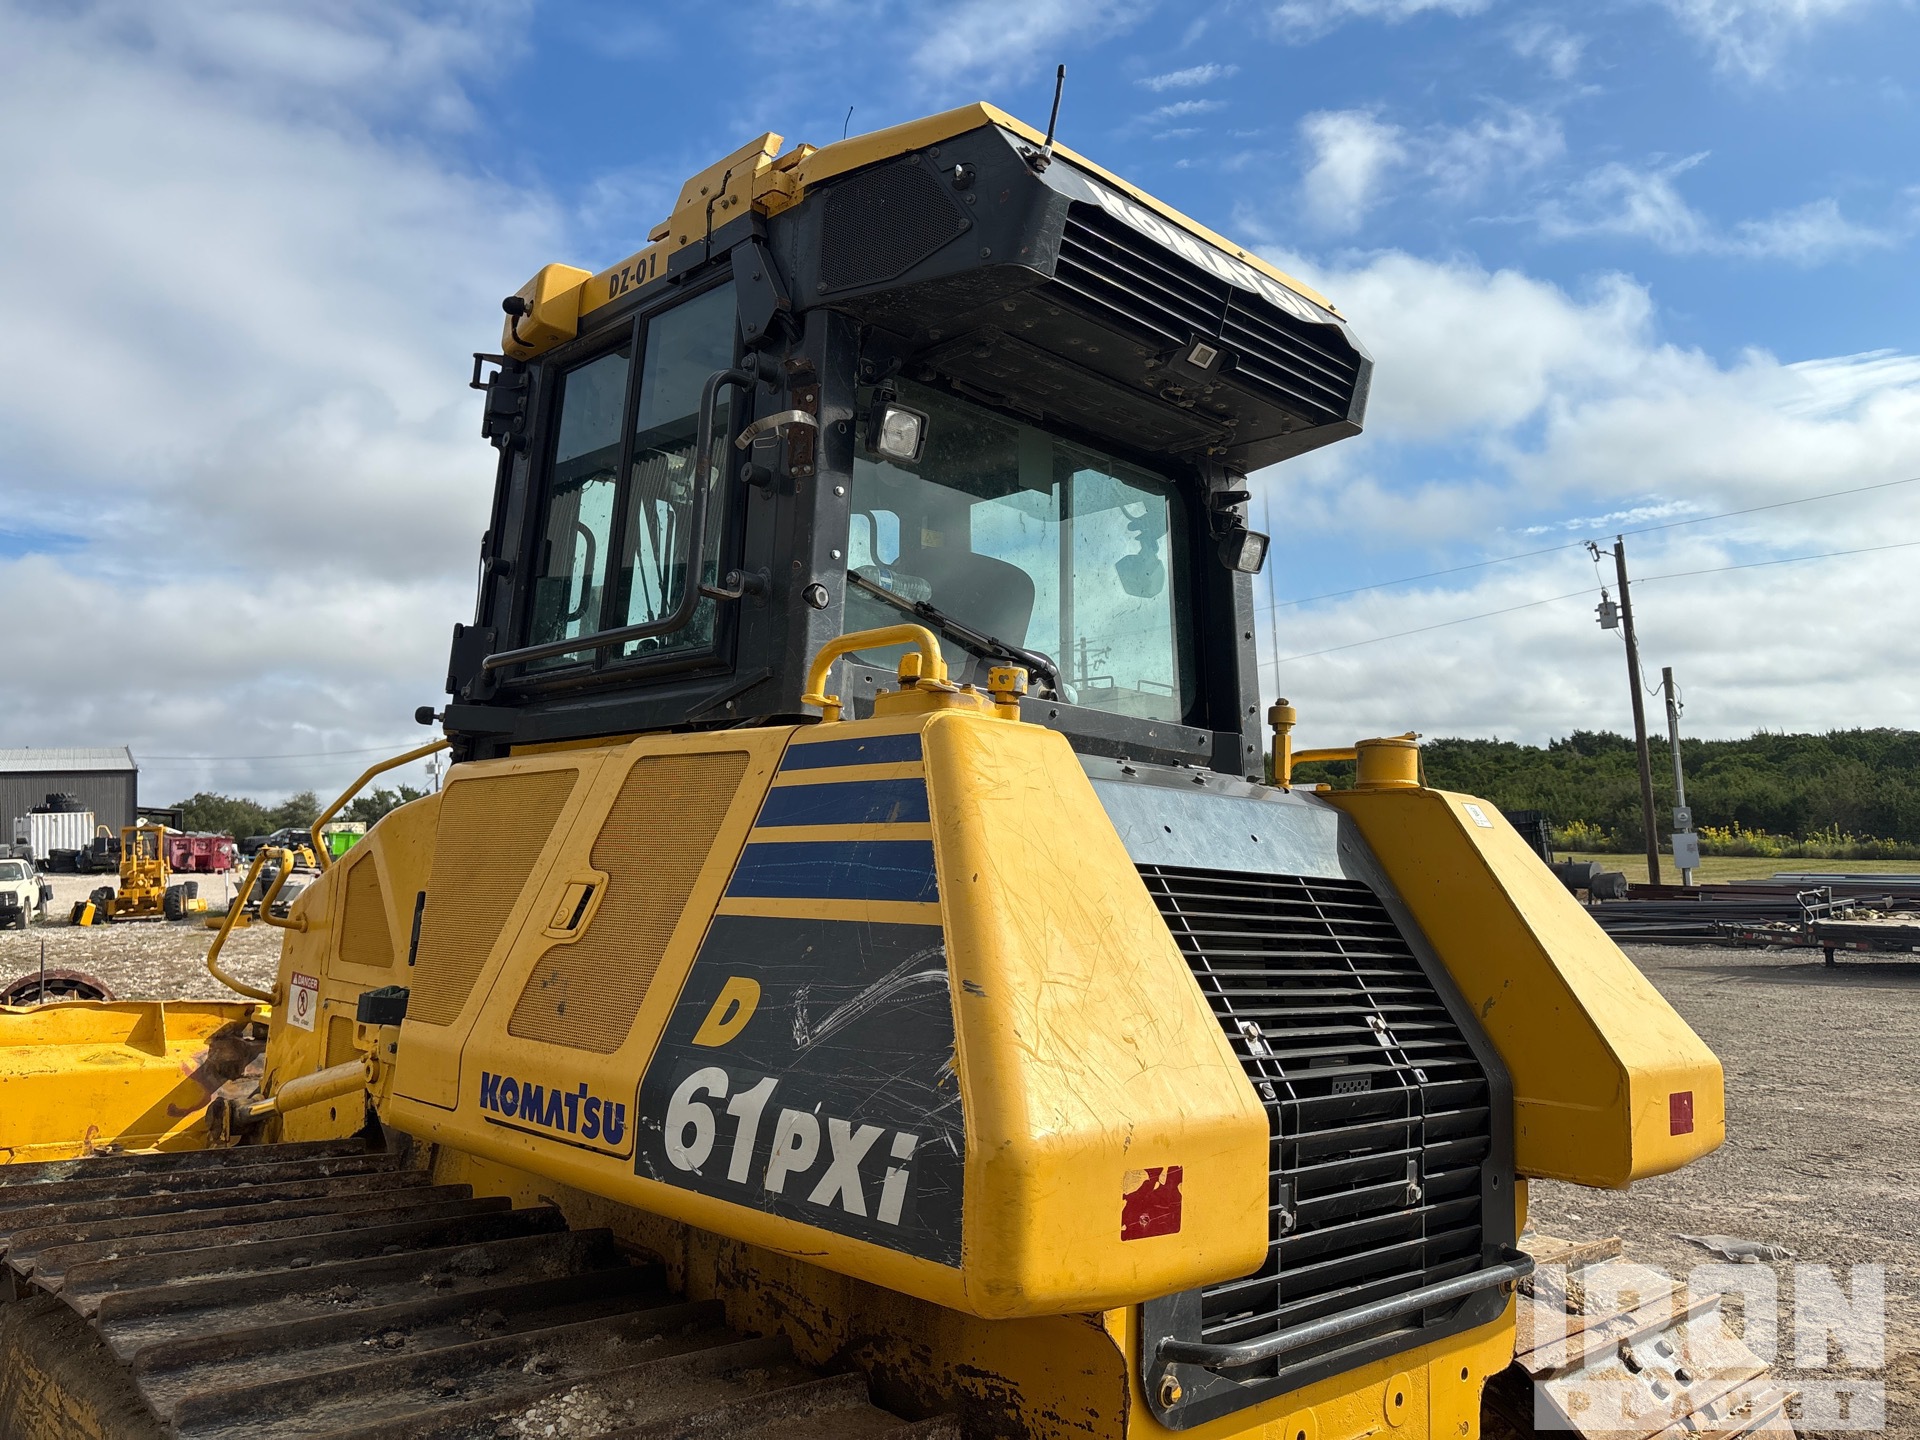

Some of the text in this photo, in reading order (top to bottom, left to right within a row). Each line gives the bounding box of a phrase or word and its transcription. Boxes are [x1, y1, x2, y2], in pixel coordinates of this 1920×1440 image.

[608, 252, 657, 300] DZ-01
[1083, 178, 1323, 324] KOMATSU
[297, 975, 318, 989] DANGER
[479, 1070, 627, 1146] KOMATSU
